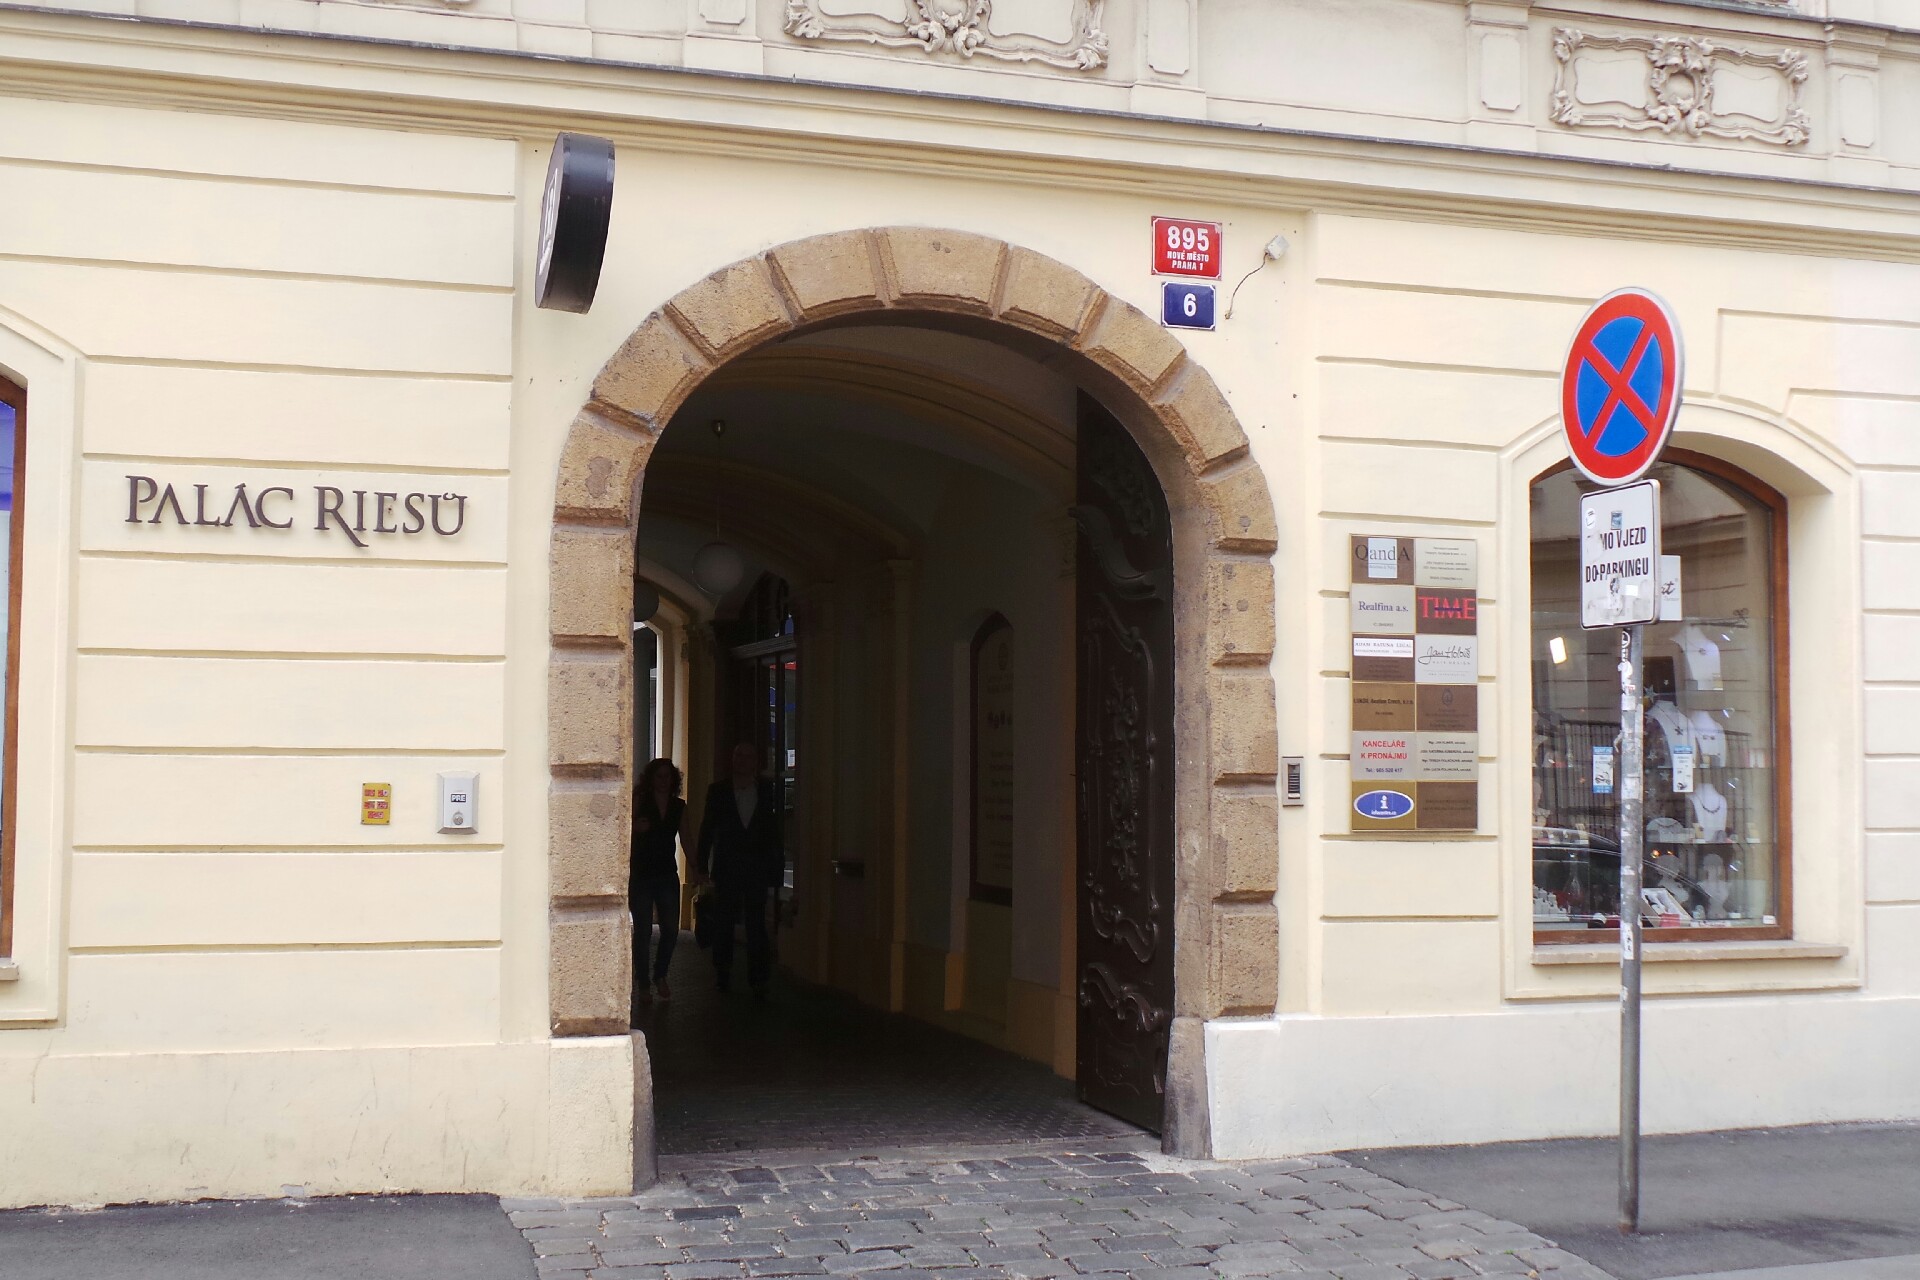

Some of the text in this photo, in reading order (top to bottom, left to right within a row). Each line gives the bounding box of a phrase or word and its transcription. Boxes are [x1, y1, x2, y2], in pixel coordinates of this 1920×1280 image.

[1168, 225, 1209, 251] 895
[1167, 250, 1209, 262] NOVÉ MĚSTO
[1172, 261, 1204, 270] PRAHA 1
[1184, 293, 1196, 317] 6
[125, 475, 468, 547] PALÁC RIESŮ
[1600, 557, 1648, 581] PARKINGU
[1358, 601, 1394, 612] Realfina
[1418, 596, 1476, 619] TIME
[1362, 739, 1406, 748] KANCELÁŘE
[1368, 751, 1408, 760] PRONÁJMU
